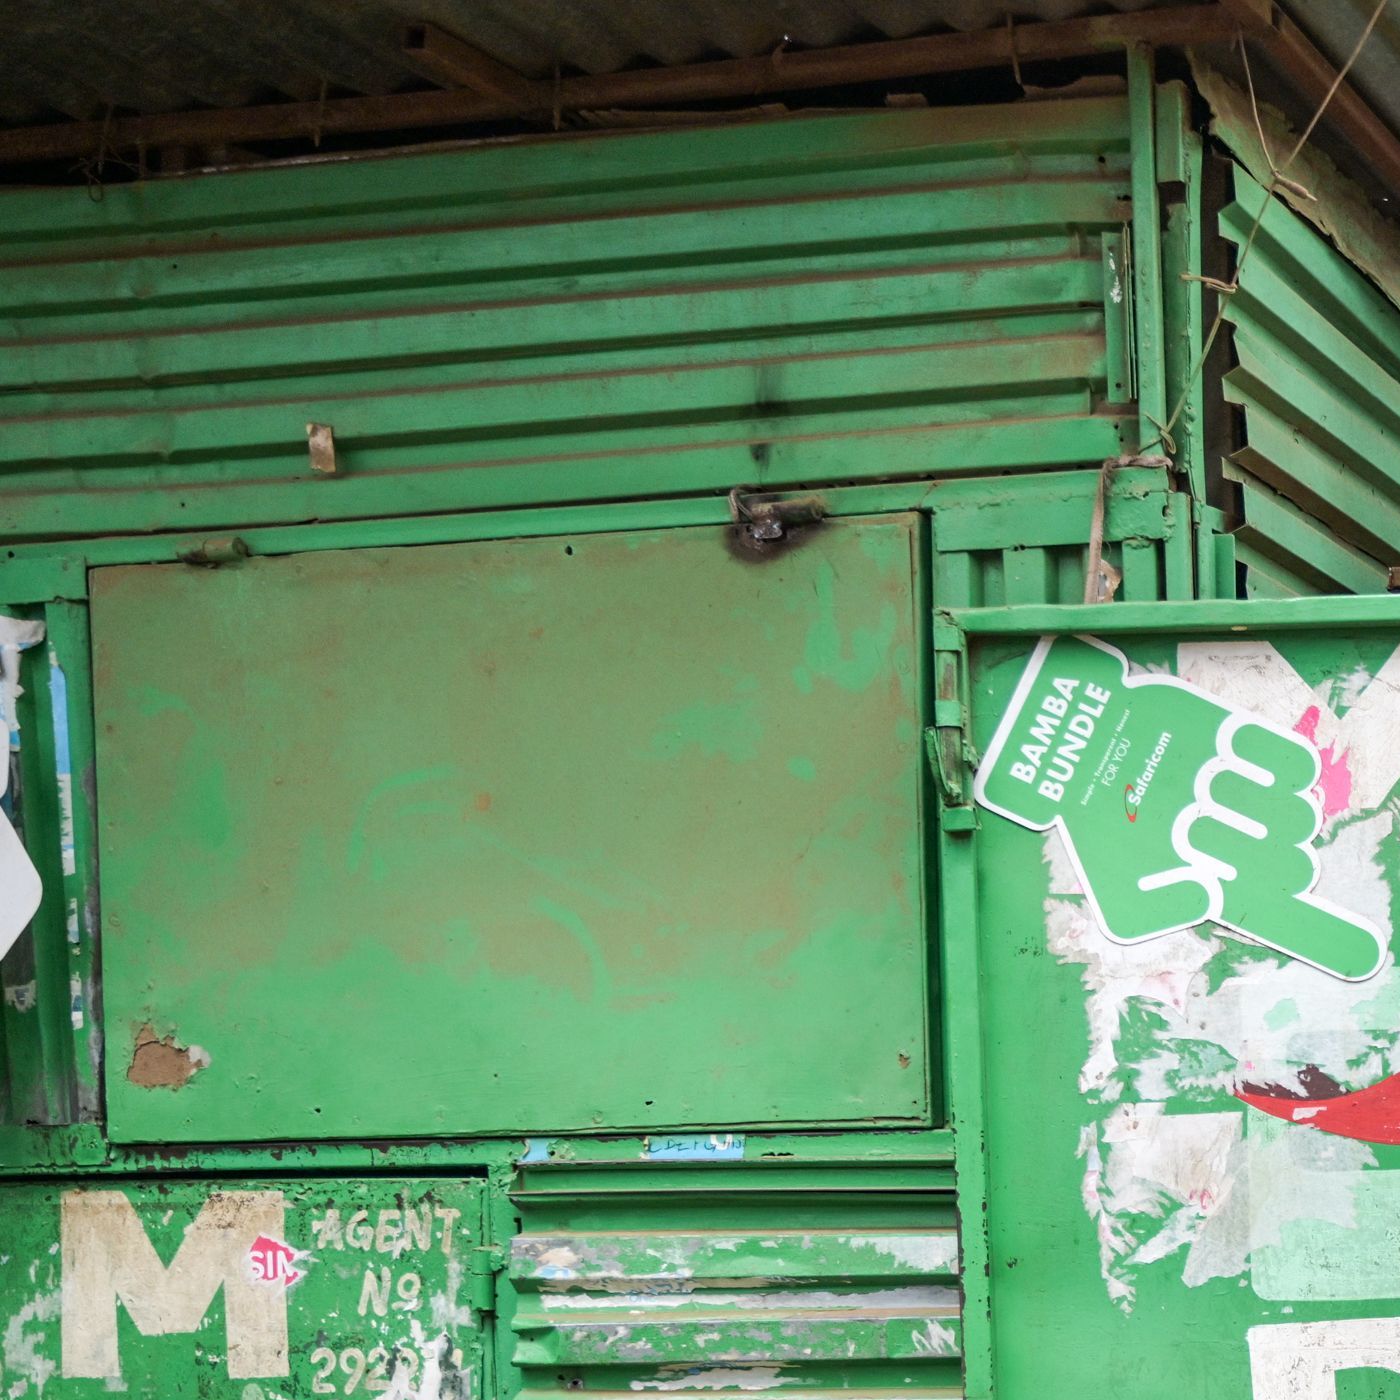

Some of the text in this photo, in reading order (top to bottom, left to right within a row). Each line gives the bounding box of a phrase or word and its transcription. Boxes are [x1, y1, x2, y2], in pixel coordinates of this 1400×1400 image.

[1009, 677, 1080, 784] BAMBA
[1037, 682, 1112, 802] BUNDLE
[1101, 738, 1132, 786] FOR YOU
[1128, 731, 1172, 806] Safaricom
[312, 1206, 461, 1256] AGENT
